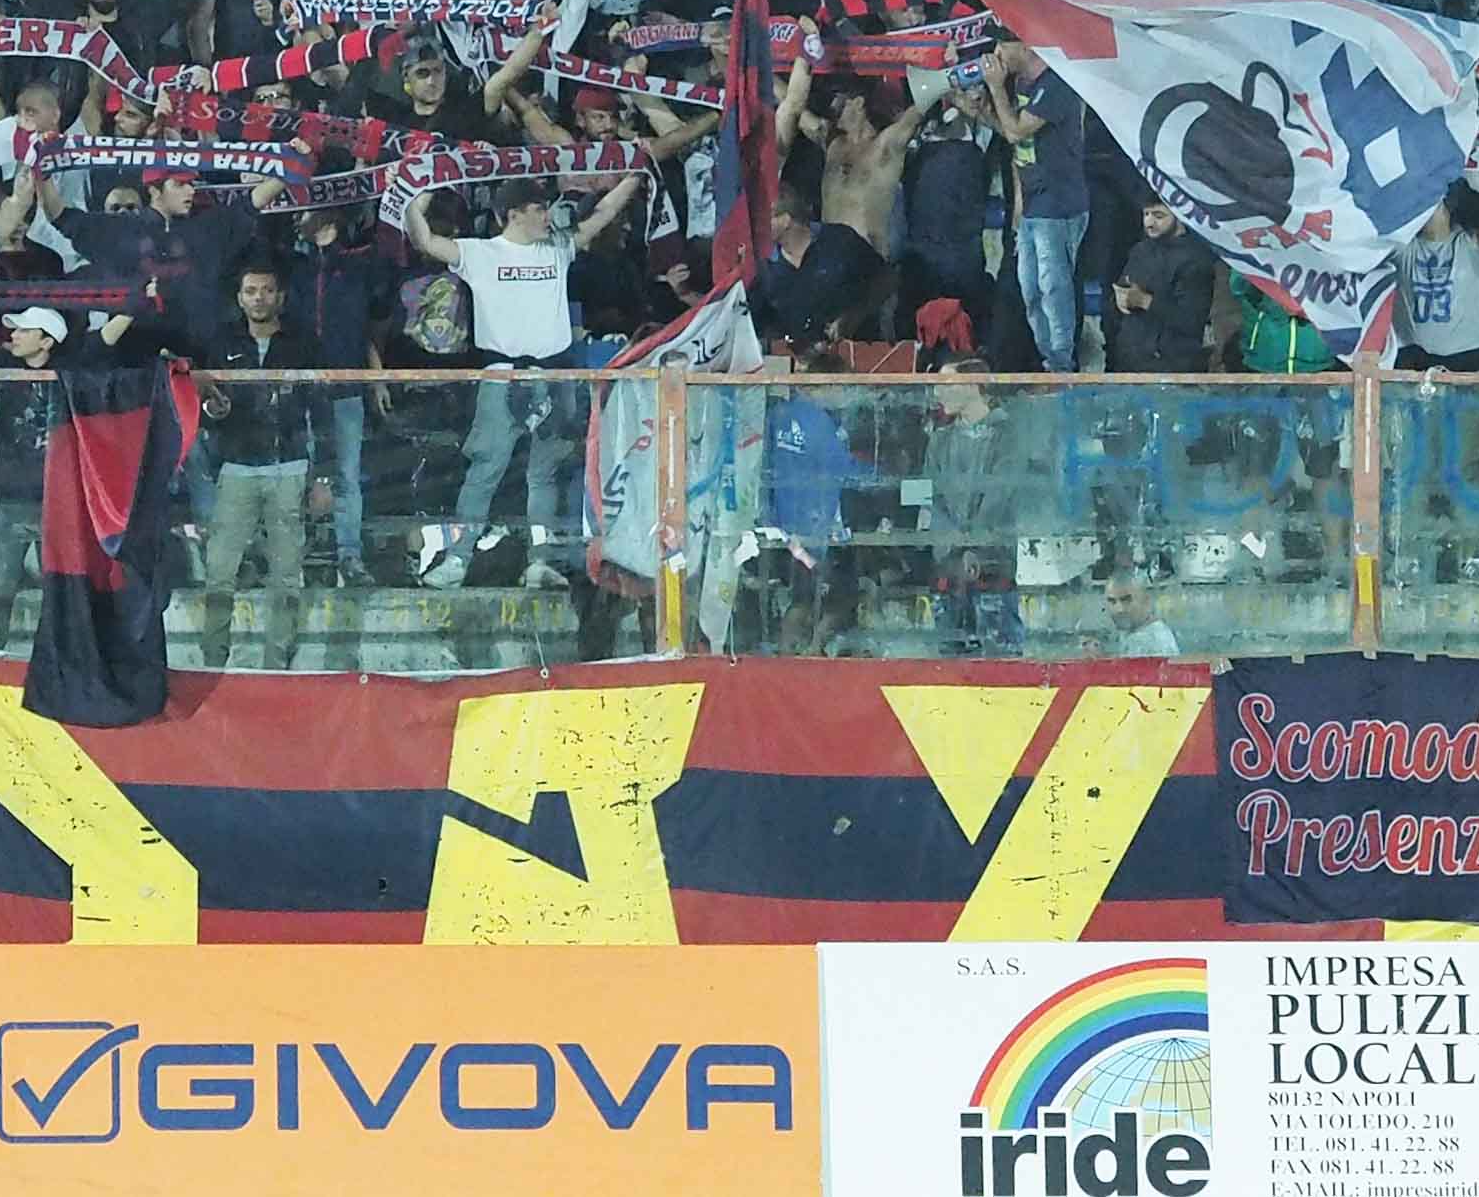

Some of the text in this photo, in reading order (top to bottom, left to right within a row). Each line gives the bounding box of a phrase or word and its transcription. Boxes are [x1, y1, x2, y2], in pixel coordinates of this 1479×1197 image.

[38, 151, 286, 177] VITA DA ULTRAS
[956, 957, 1027, 977] S.A.S.
[1266, 955, 1465, 988] IMPRESA
[138, 1042, 794, 1132] GIVOVA
[1268, 1092, 1418, 1108] 80132 NAPOLI
[1269, 1115, 1310, 1130] VIA
[1423, 1115, 1454, 1130] 210
[960, 1112, 1211, 1197] iride
[1438, 1137, 1461, 1153] 88
[1271, 1159, 1313, 1176] FAX
[1432, 1159, 1455, 1176] 88
